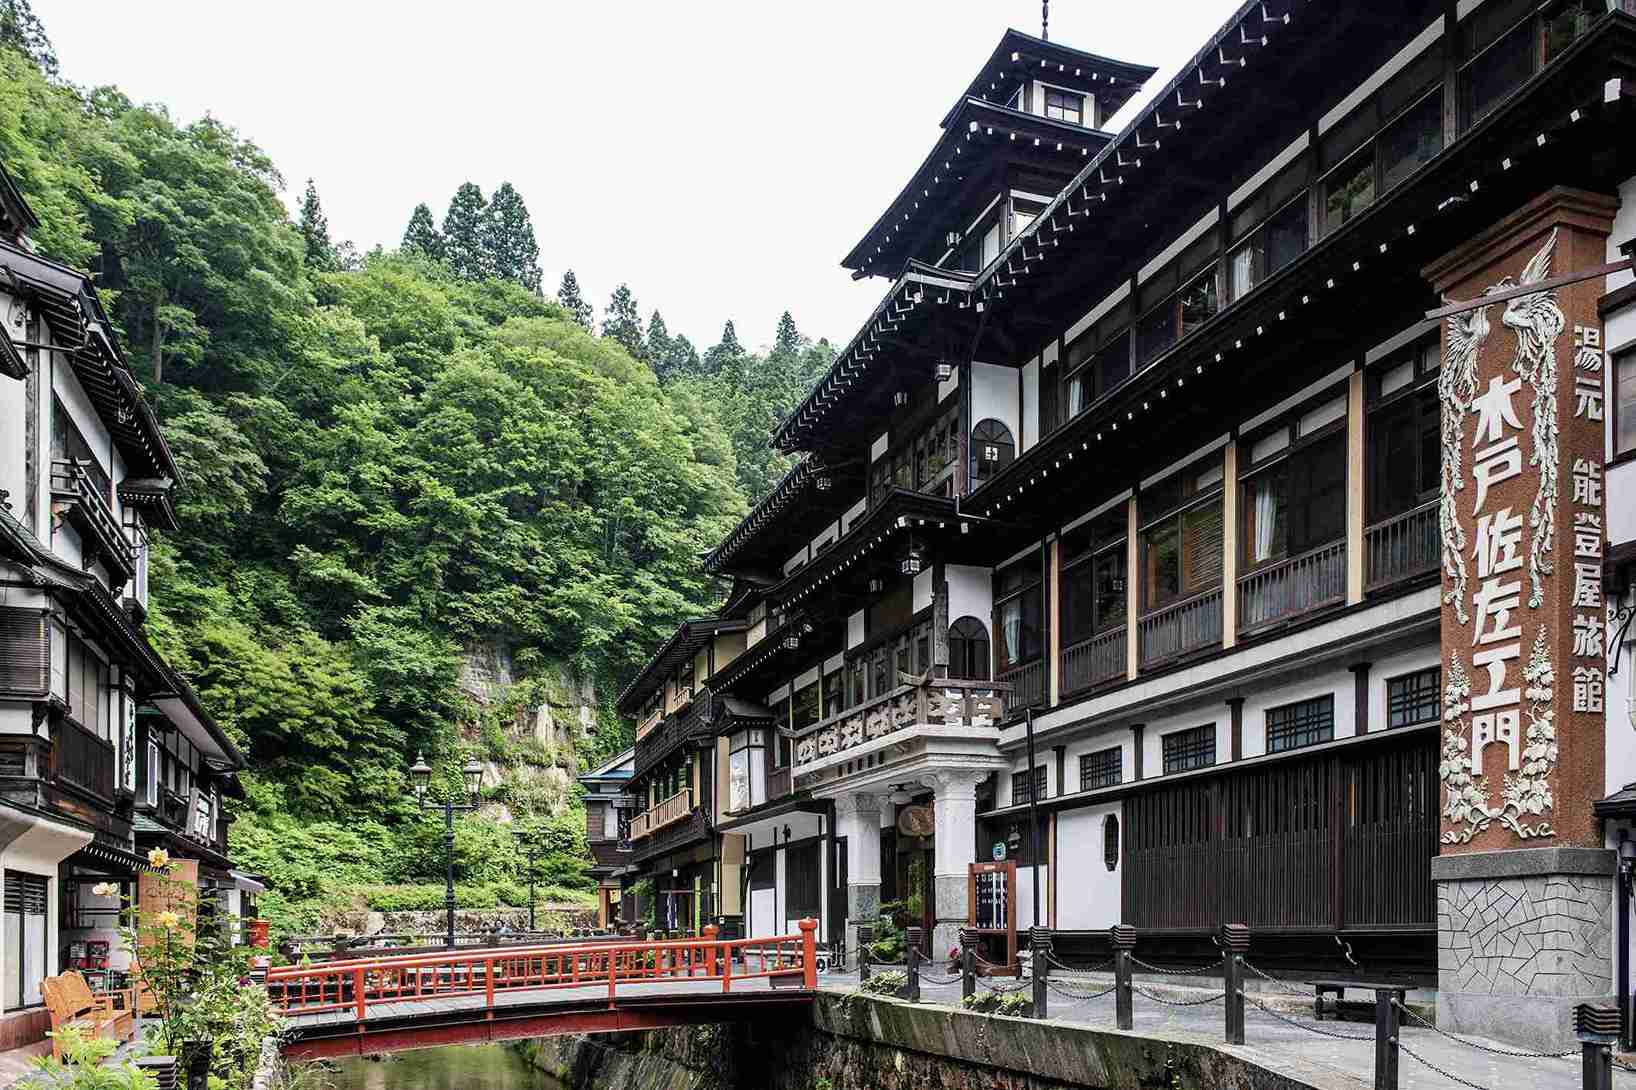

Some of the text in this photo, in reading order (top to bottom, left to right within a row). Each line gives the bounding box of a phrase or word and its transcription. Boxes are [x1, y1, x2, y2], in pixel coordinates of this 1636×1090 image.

[1571, 324, 1605, 714] 湯元 能登屋旅館
